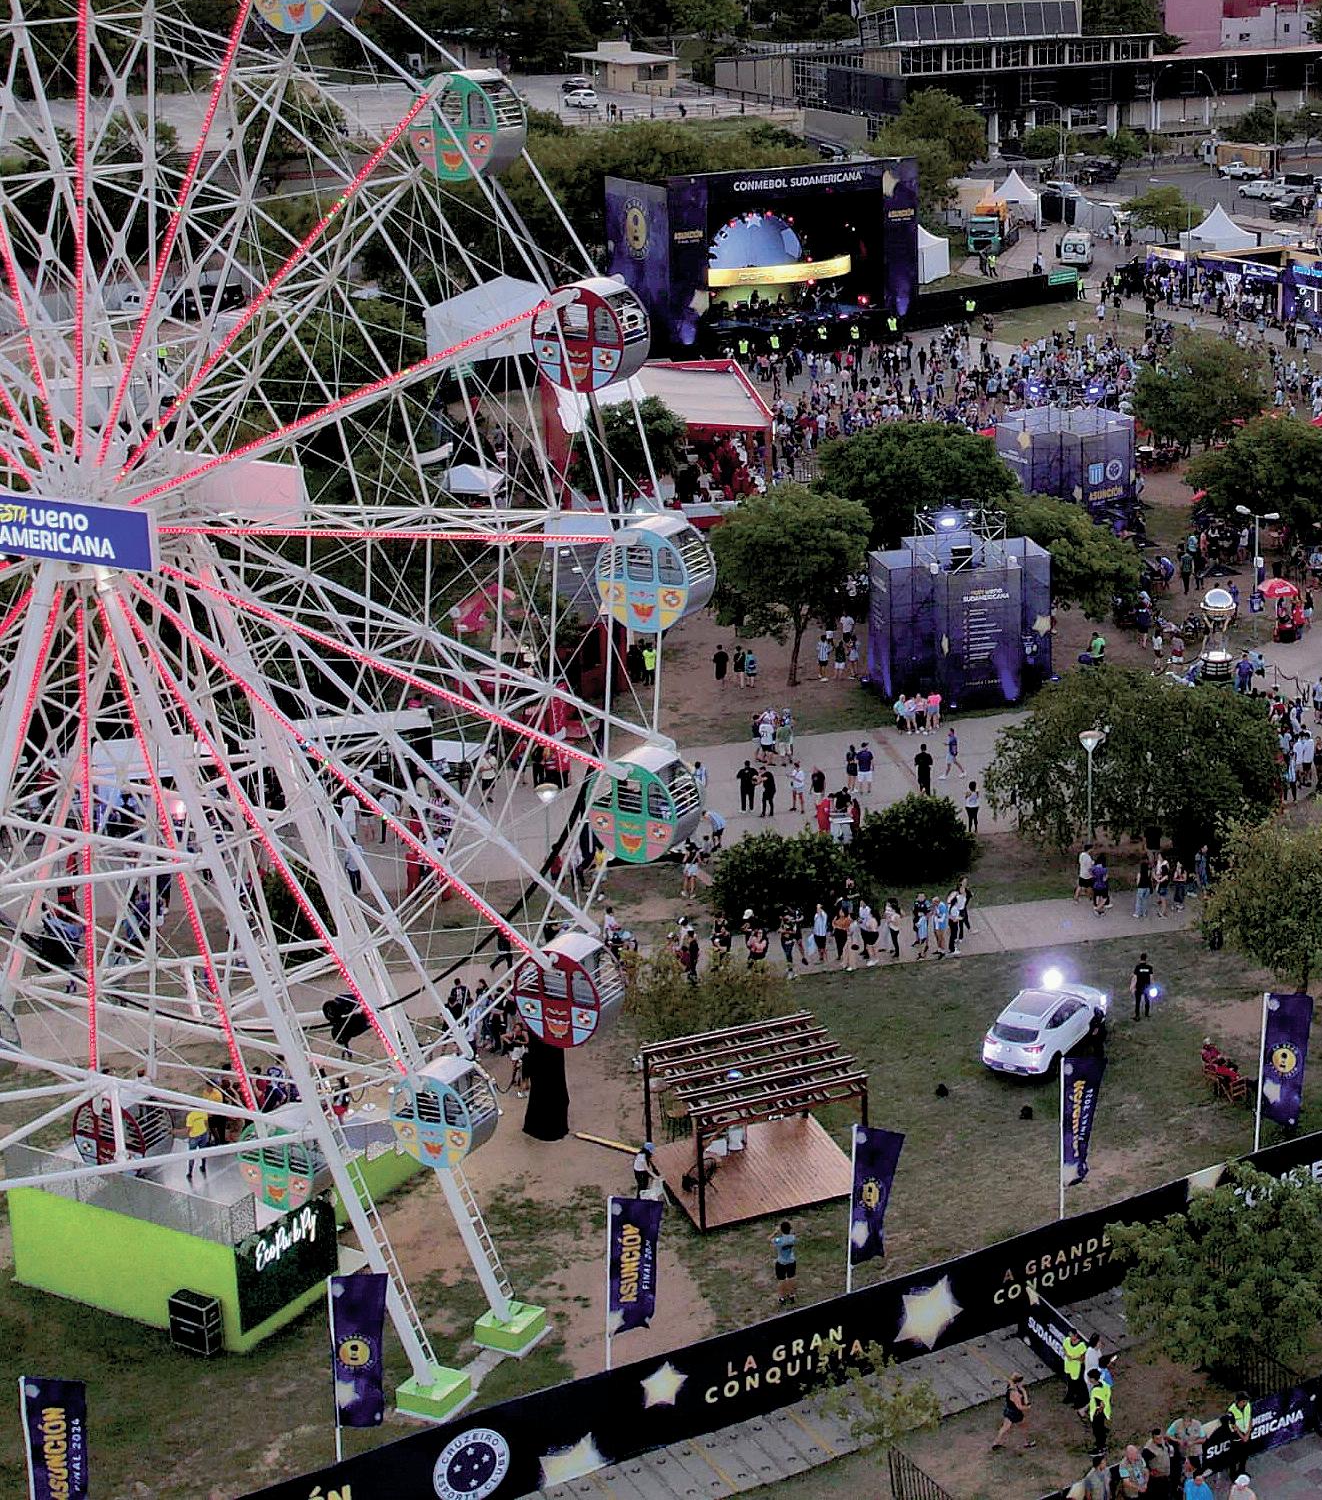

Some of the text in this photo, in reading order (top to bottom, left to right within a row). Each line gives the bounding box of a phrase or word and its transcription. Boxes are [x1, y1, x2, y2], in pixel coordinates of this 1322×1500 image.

[733, 172, 862, 192] CONMEBOL SUDAMERICANA
[618, 1223, 642, 1303] ASUNCIÓN
[1002, 1235, 1112, 1283] A GRANDE
[705, 1339, 864, 1404] CONQUISTA
[727, 1325, 843, 1377] LA GRAN
[441, 1433, 500, 1465] CRUZEIRO
